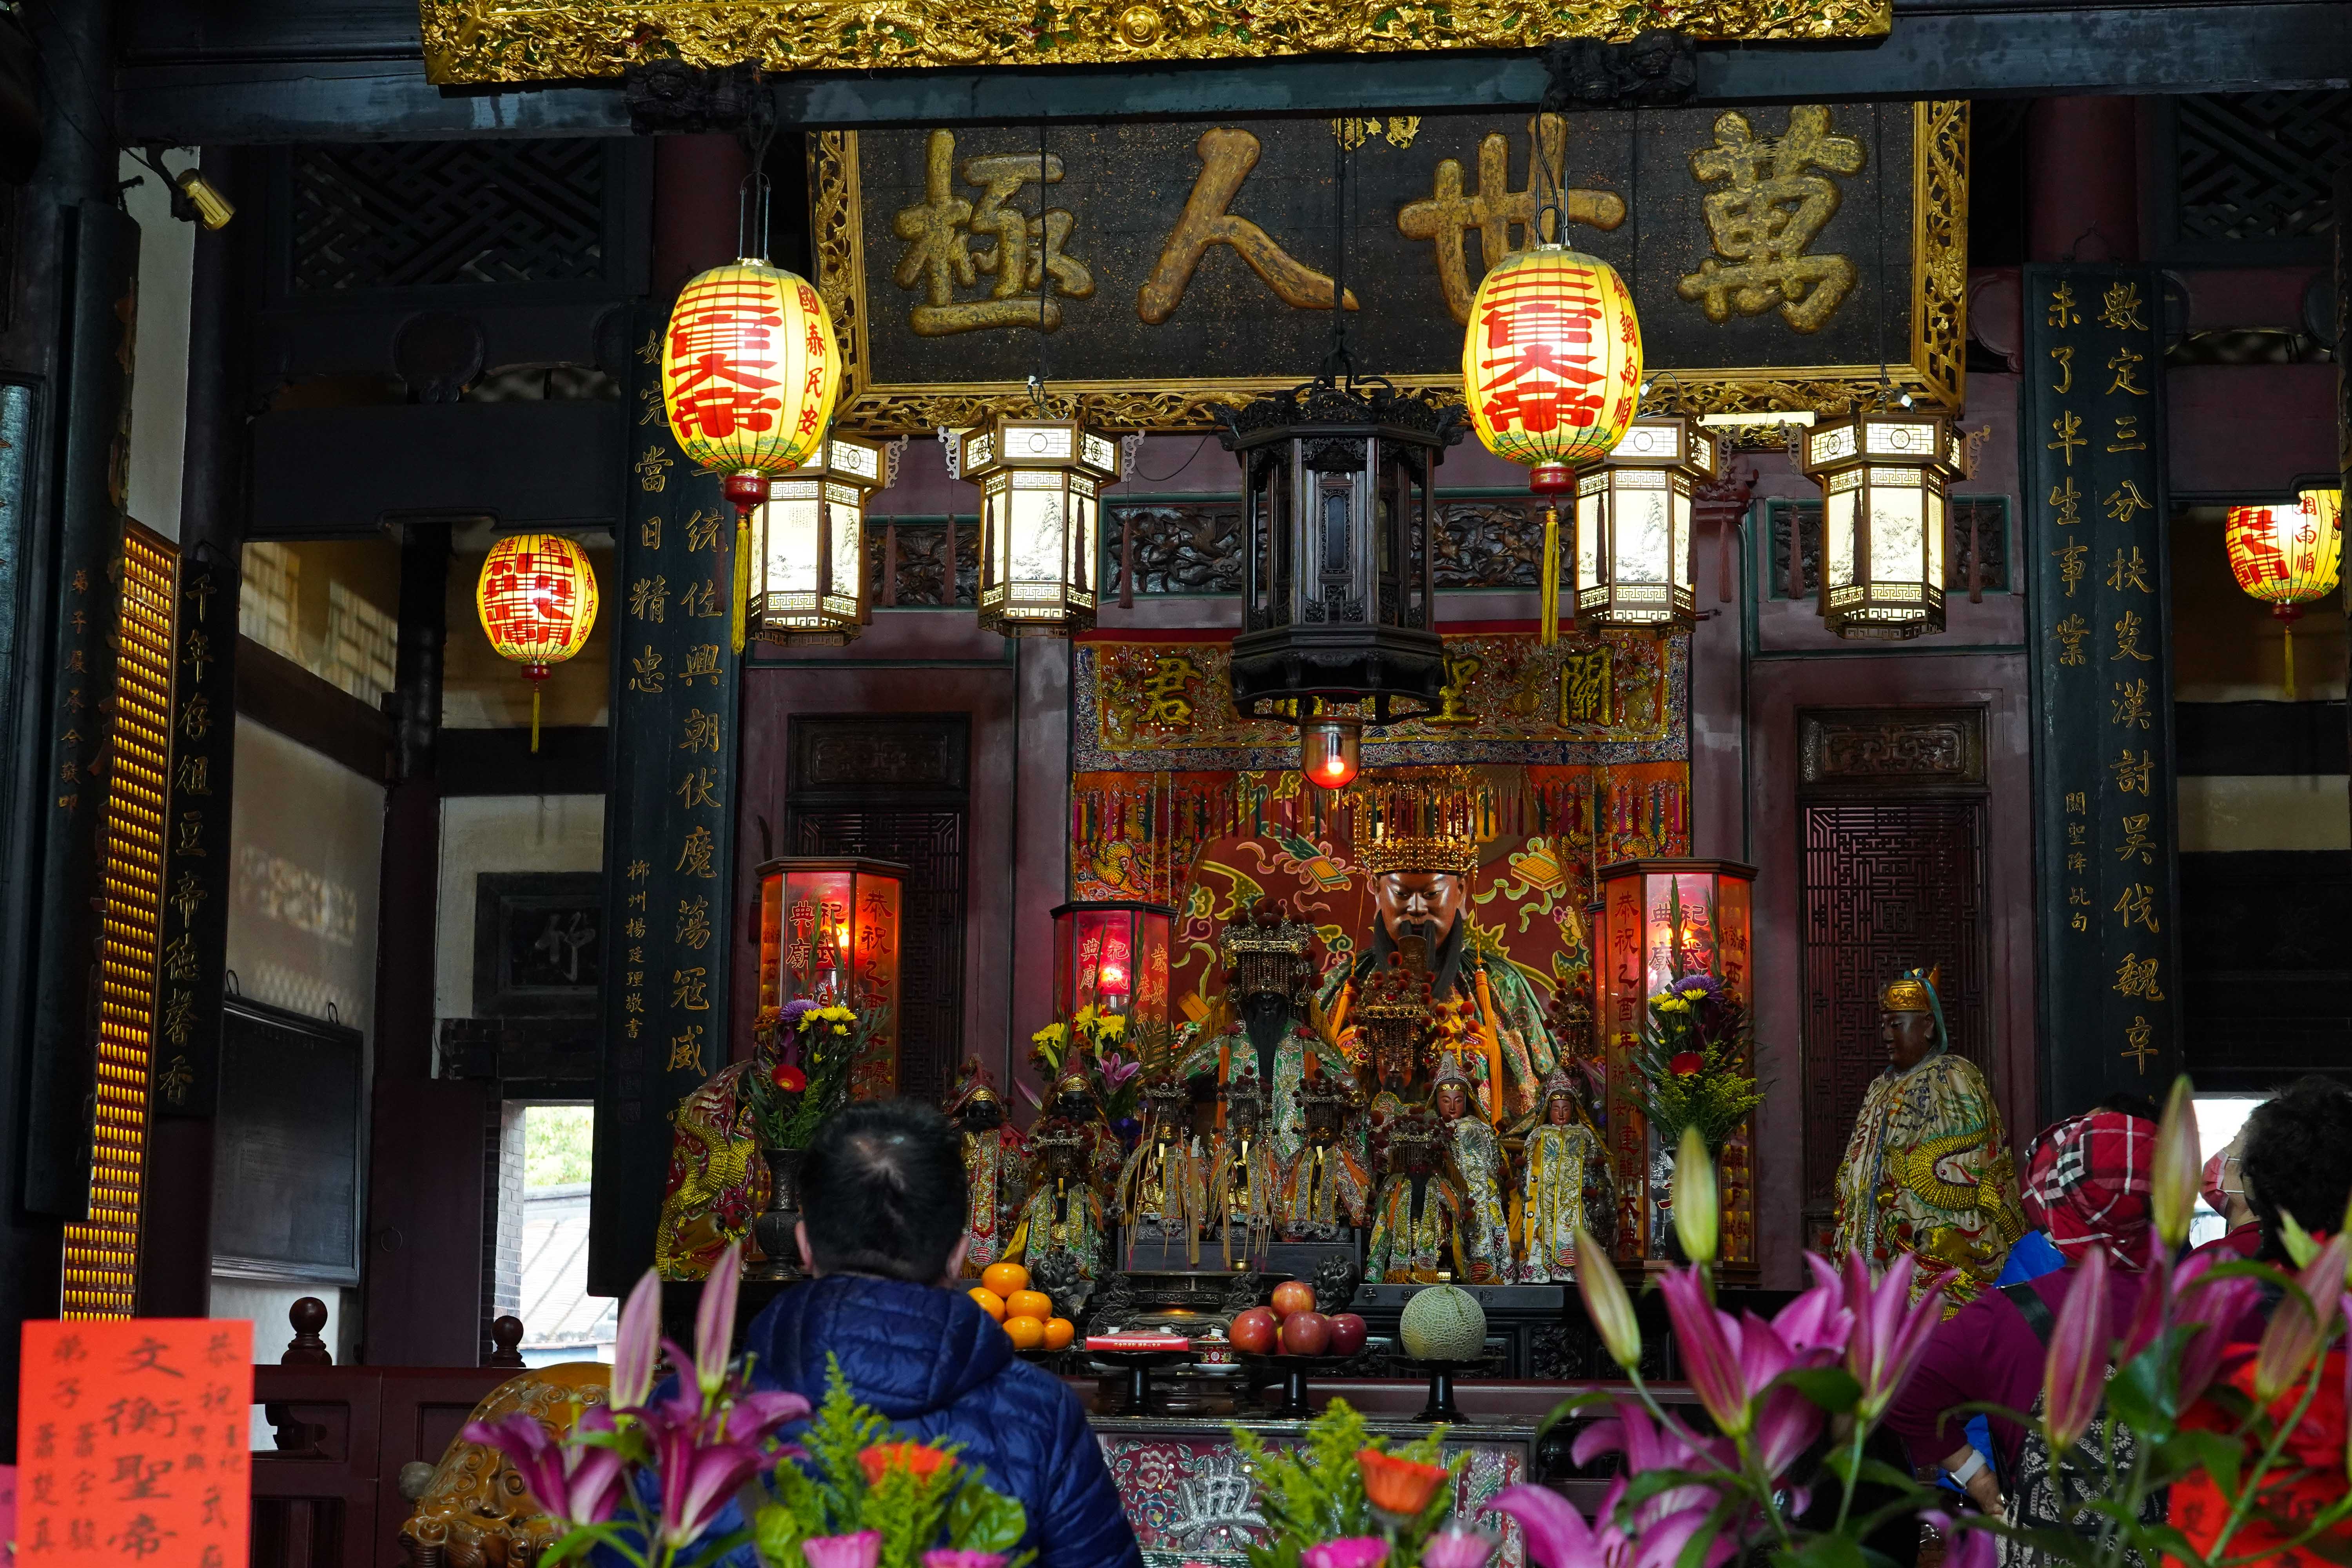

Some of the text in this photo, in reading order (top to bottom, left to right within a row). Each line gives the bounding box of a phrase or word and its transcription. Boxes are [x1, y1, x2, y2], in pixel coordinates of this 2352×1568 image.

[669, 281, 782, 438] 三官大帝
[797, 285, 825, 436] 國泰民安
[1480, 269, 1606, 432] 三官大帝
[2048, 281, 2091, 666] 未了半生事業
[484, 553, 576, 646] 祀典武廟
[1614, 891, 1639, 1056] 恭祝乙酉年
